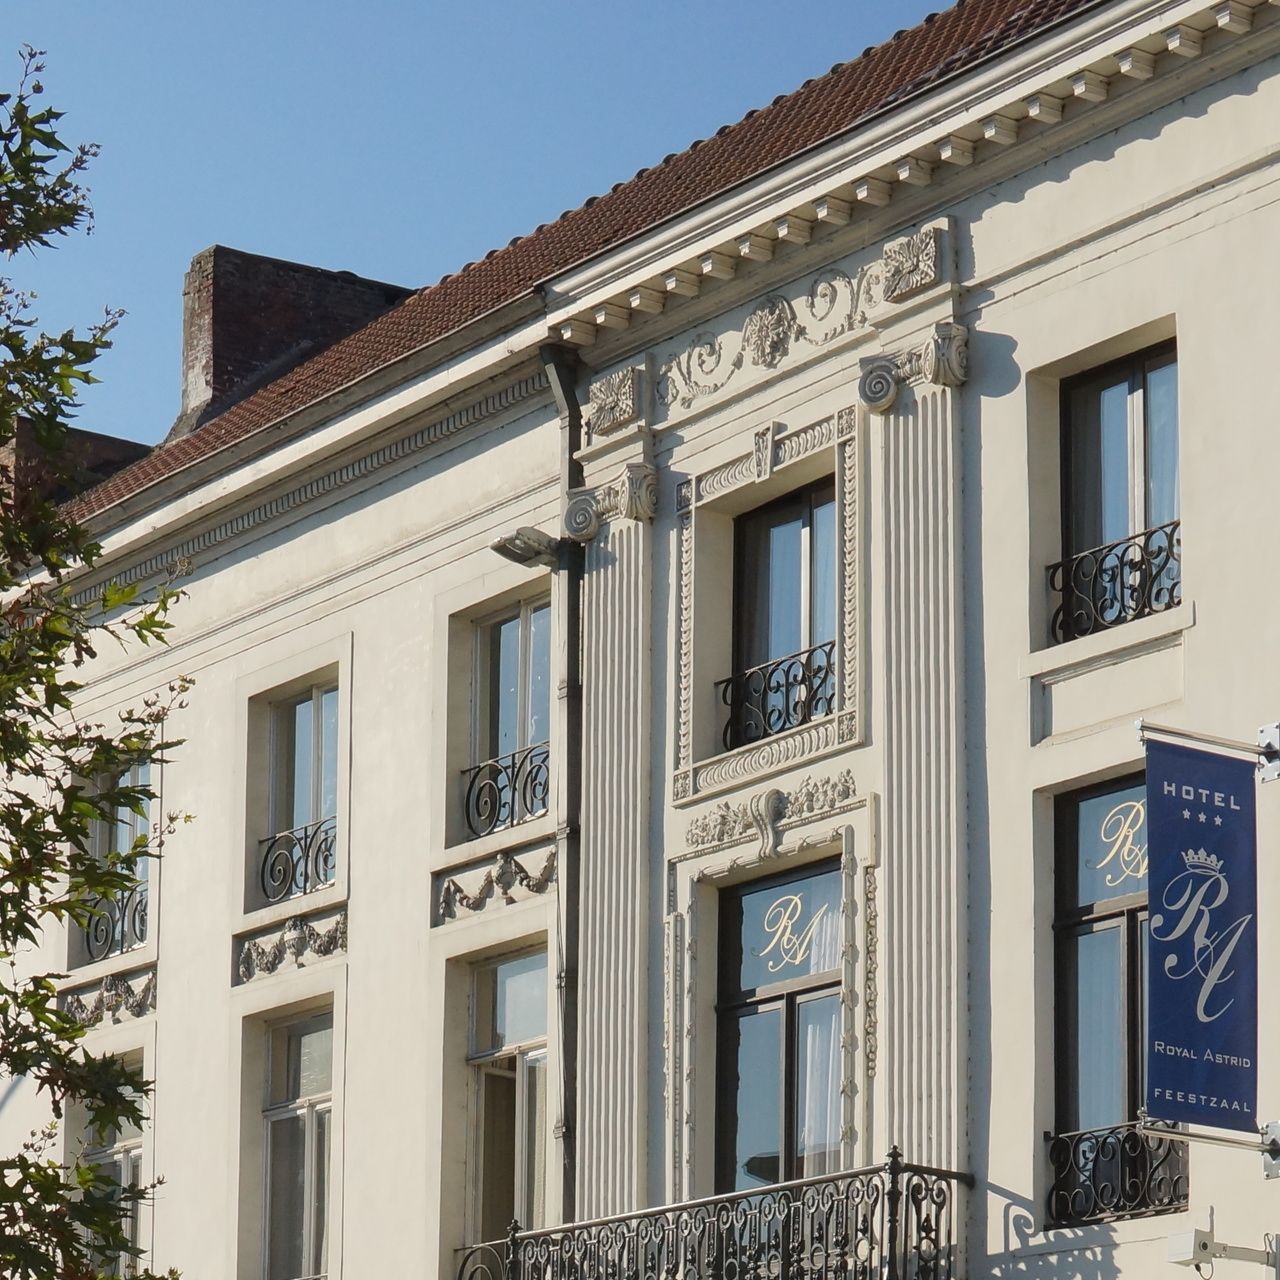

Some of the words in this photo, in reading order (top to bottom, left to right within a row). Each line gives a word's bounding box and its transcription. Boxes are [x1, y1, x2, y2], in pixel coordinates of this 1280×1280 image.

[1163, 781, 1241, 810] HOTEL
[1155, 1041, 1197, 1059] ROYAL
[1204, 1049, 1251, 1068] ASTRID
[1154, 1088, 1251, 1112] FEESTZAAL
